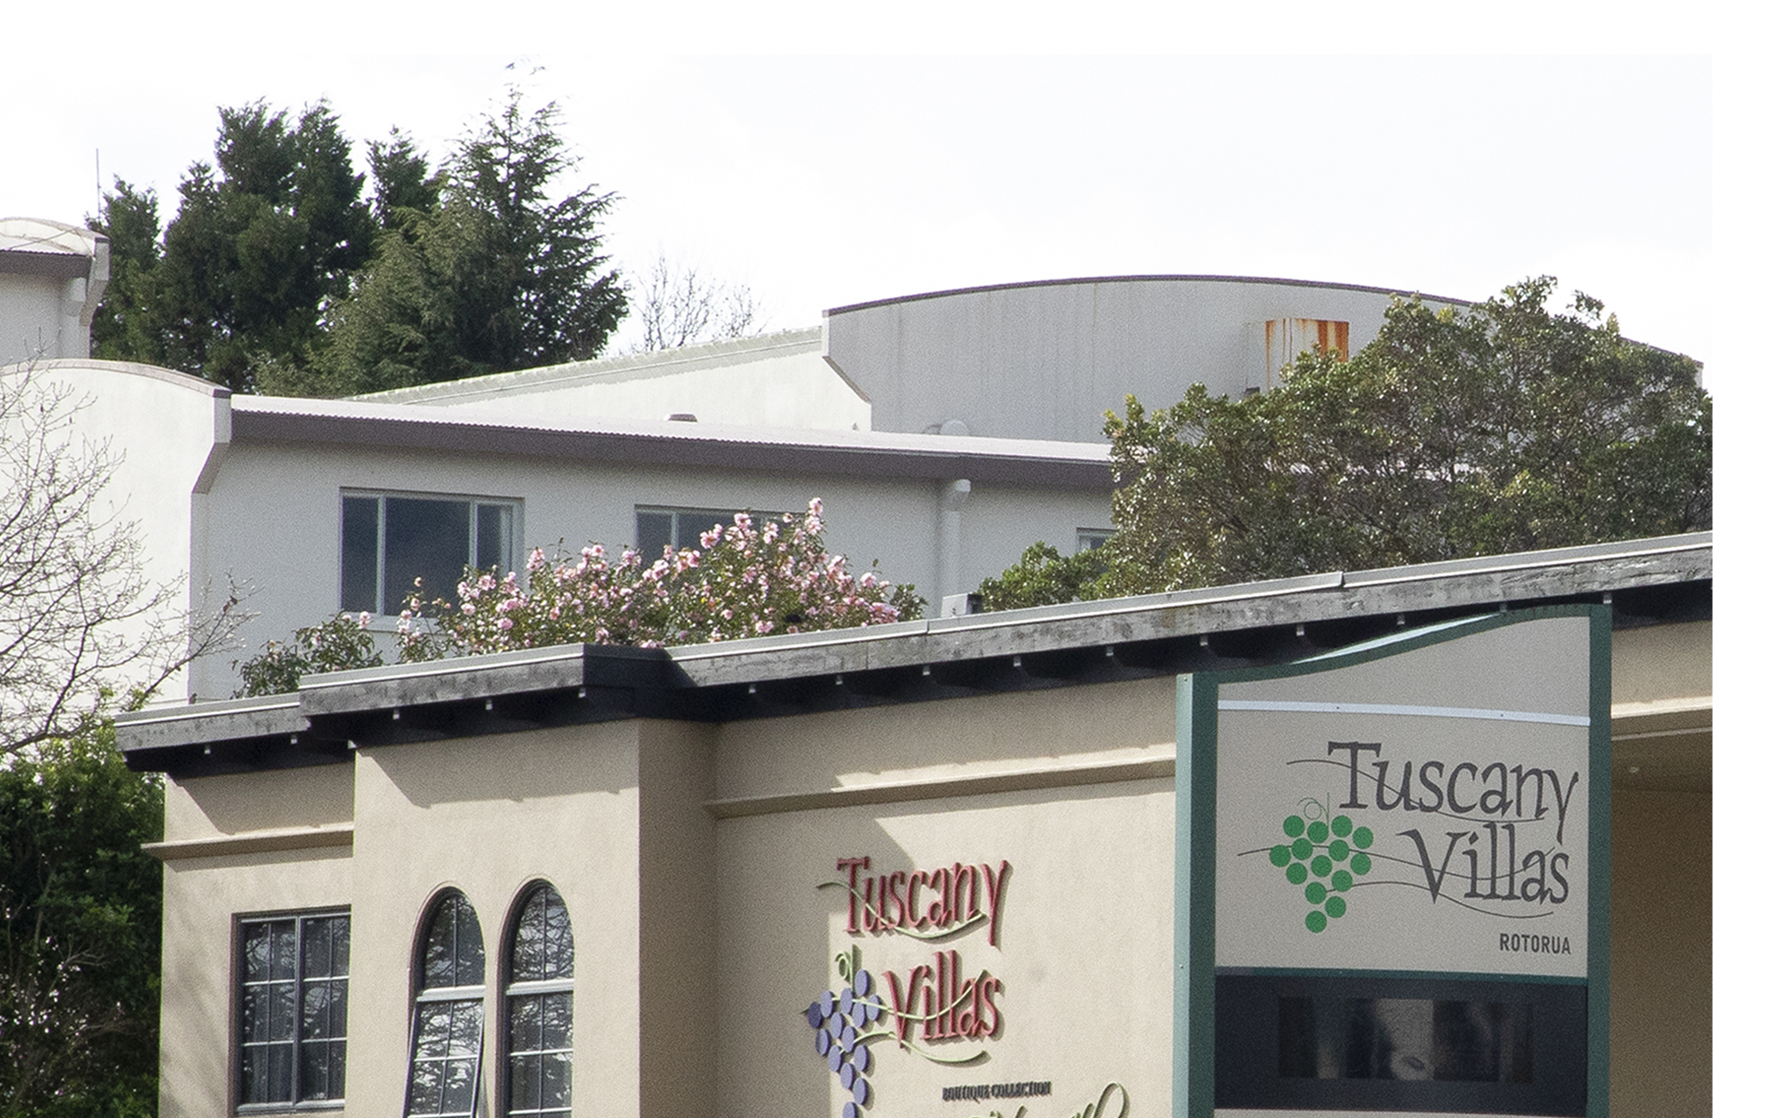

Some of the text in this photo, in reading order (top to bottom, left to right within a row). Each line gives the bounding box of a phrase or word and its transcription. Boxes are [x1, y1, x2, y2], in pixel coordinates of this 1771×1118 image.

[1327, 741, 1580, 844] Tuscany
[836, 856, 1011, 946] Tuscany
[1396, 821, 1570, 904] Villas
[1500, 933, 1572, 955] ROTORUA
[883, 949, 1001, 1049] Villas
[942, 1081, 1052, 1103] BOUTIQUE COLLECTION
